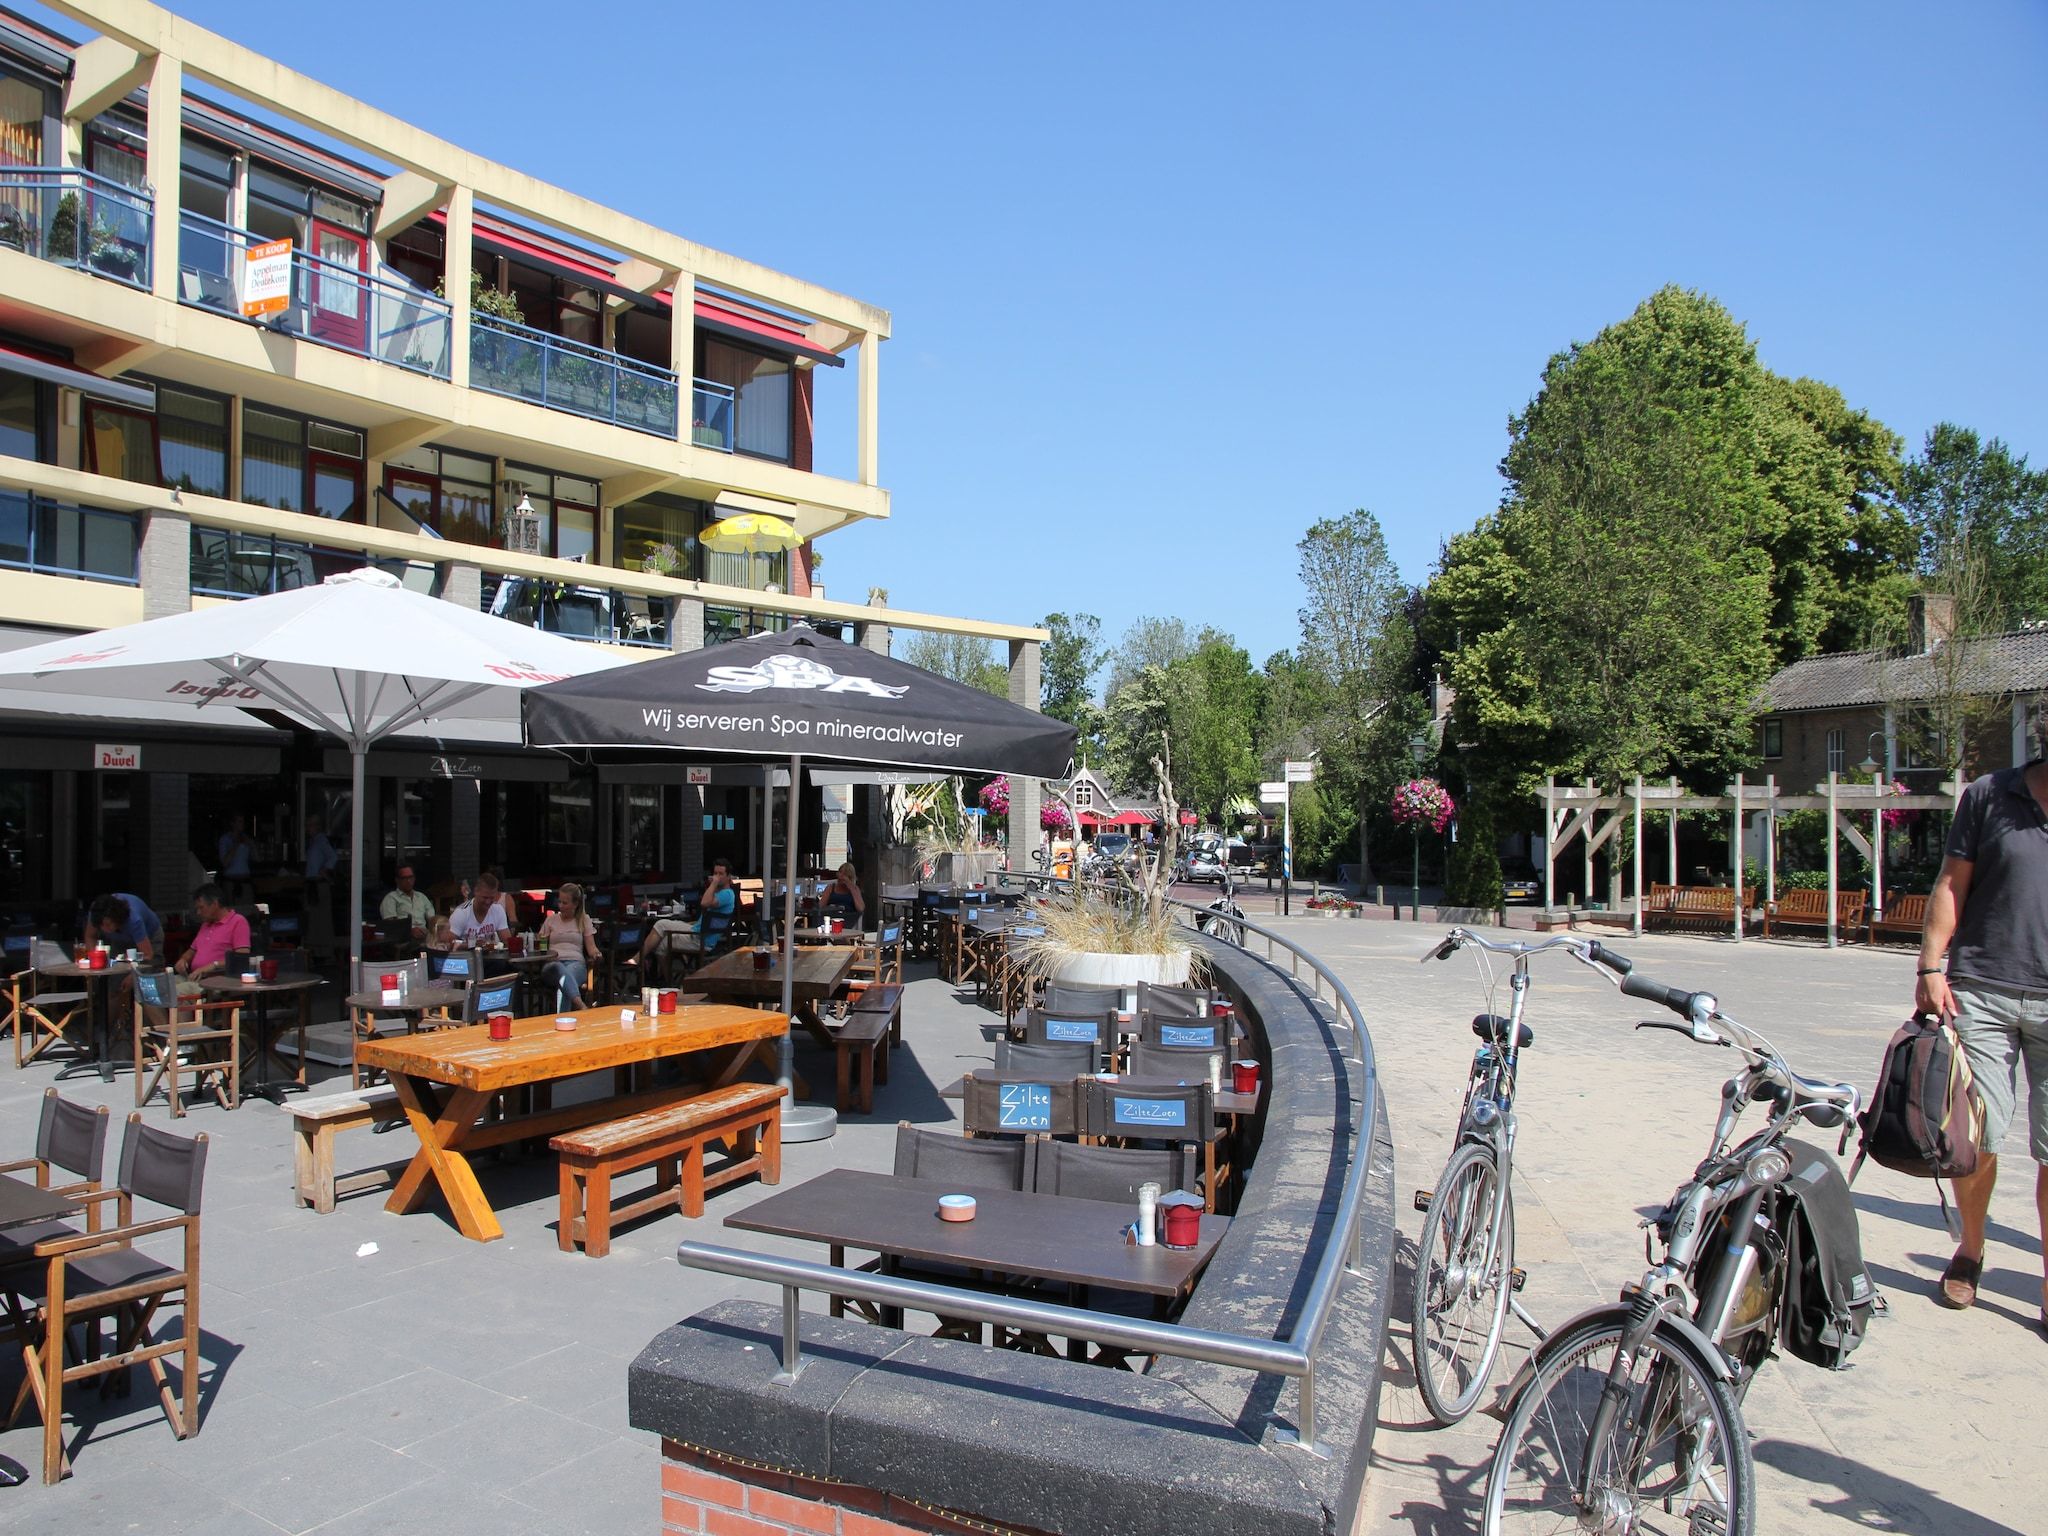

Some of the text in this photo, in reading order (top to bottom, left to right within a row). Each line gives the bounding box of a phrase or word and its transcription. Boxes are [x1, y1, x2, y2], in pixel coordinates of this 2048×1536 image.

[255, 243, 288, 258] TE KOOP
[705, 666, 904, 700] SPA
[642, 708, 964, 748] Wij serveren Spa mineraalwater
[103, 752, 135, 767] Duvel
[1001, 1084, 1049, 1107] Zilte
[1000, 1104, 1048, 1126] Zoen
[1123, 1103, 1177, 1118] ZilteZoen
